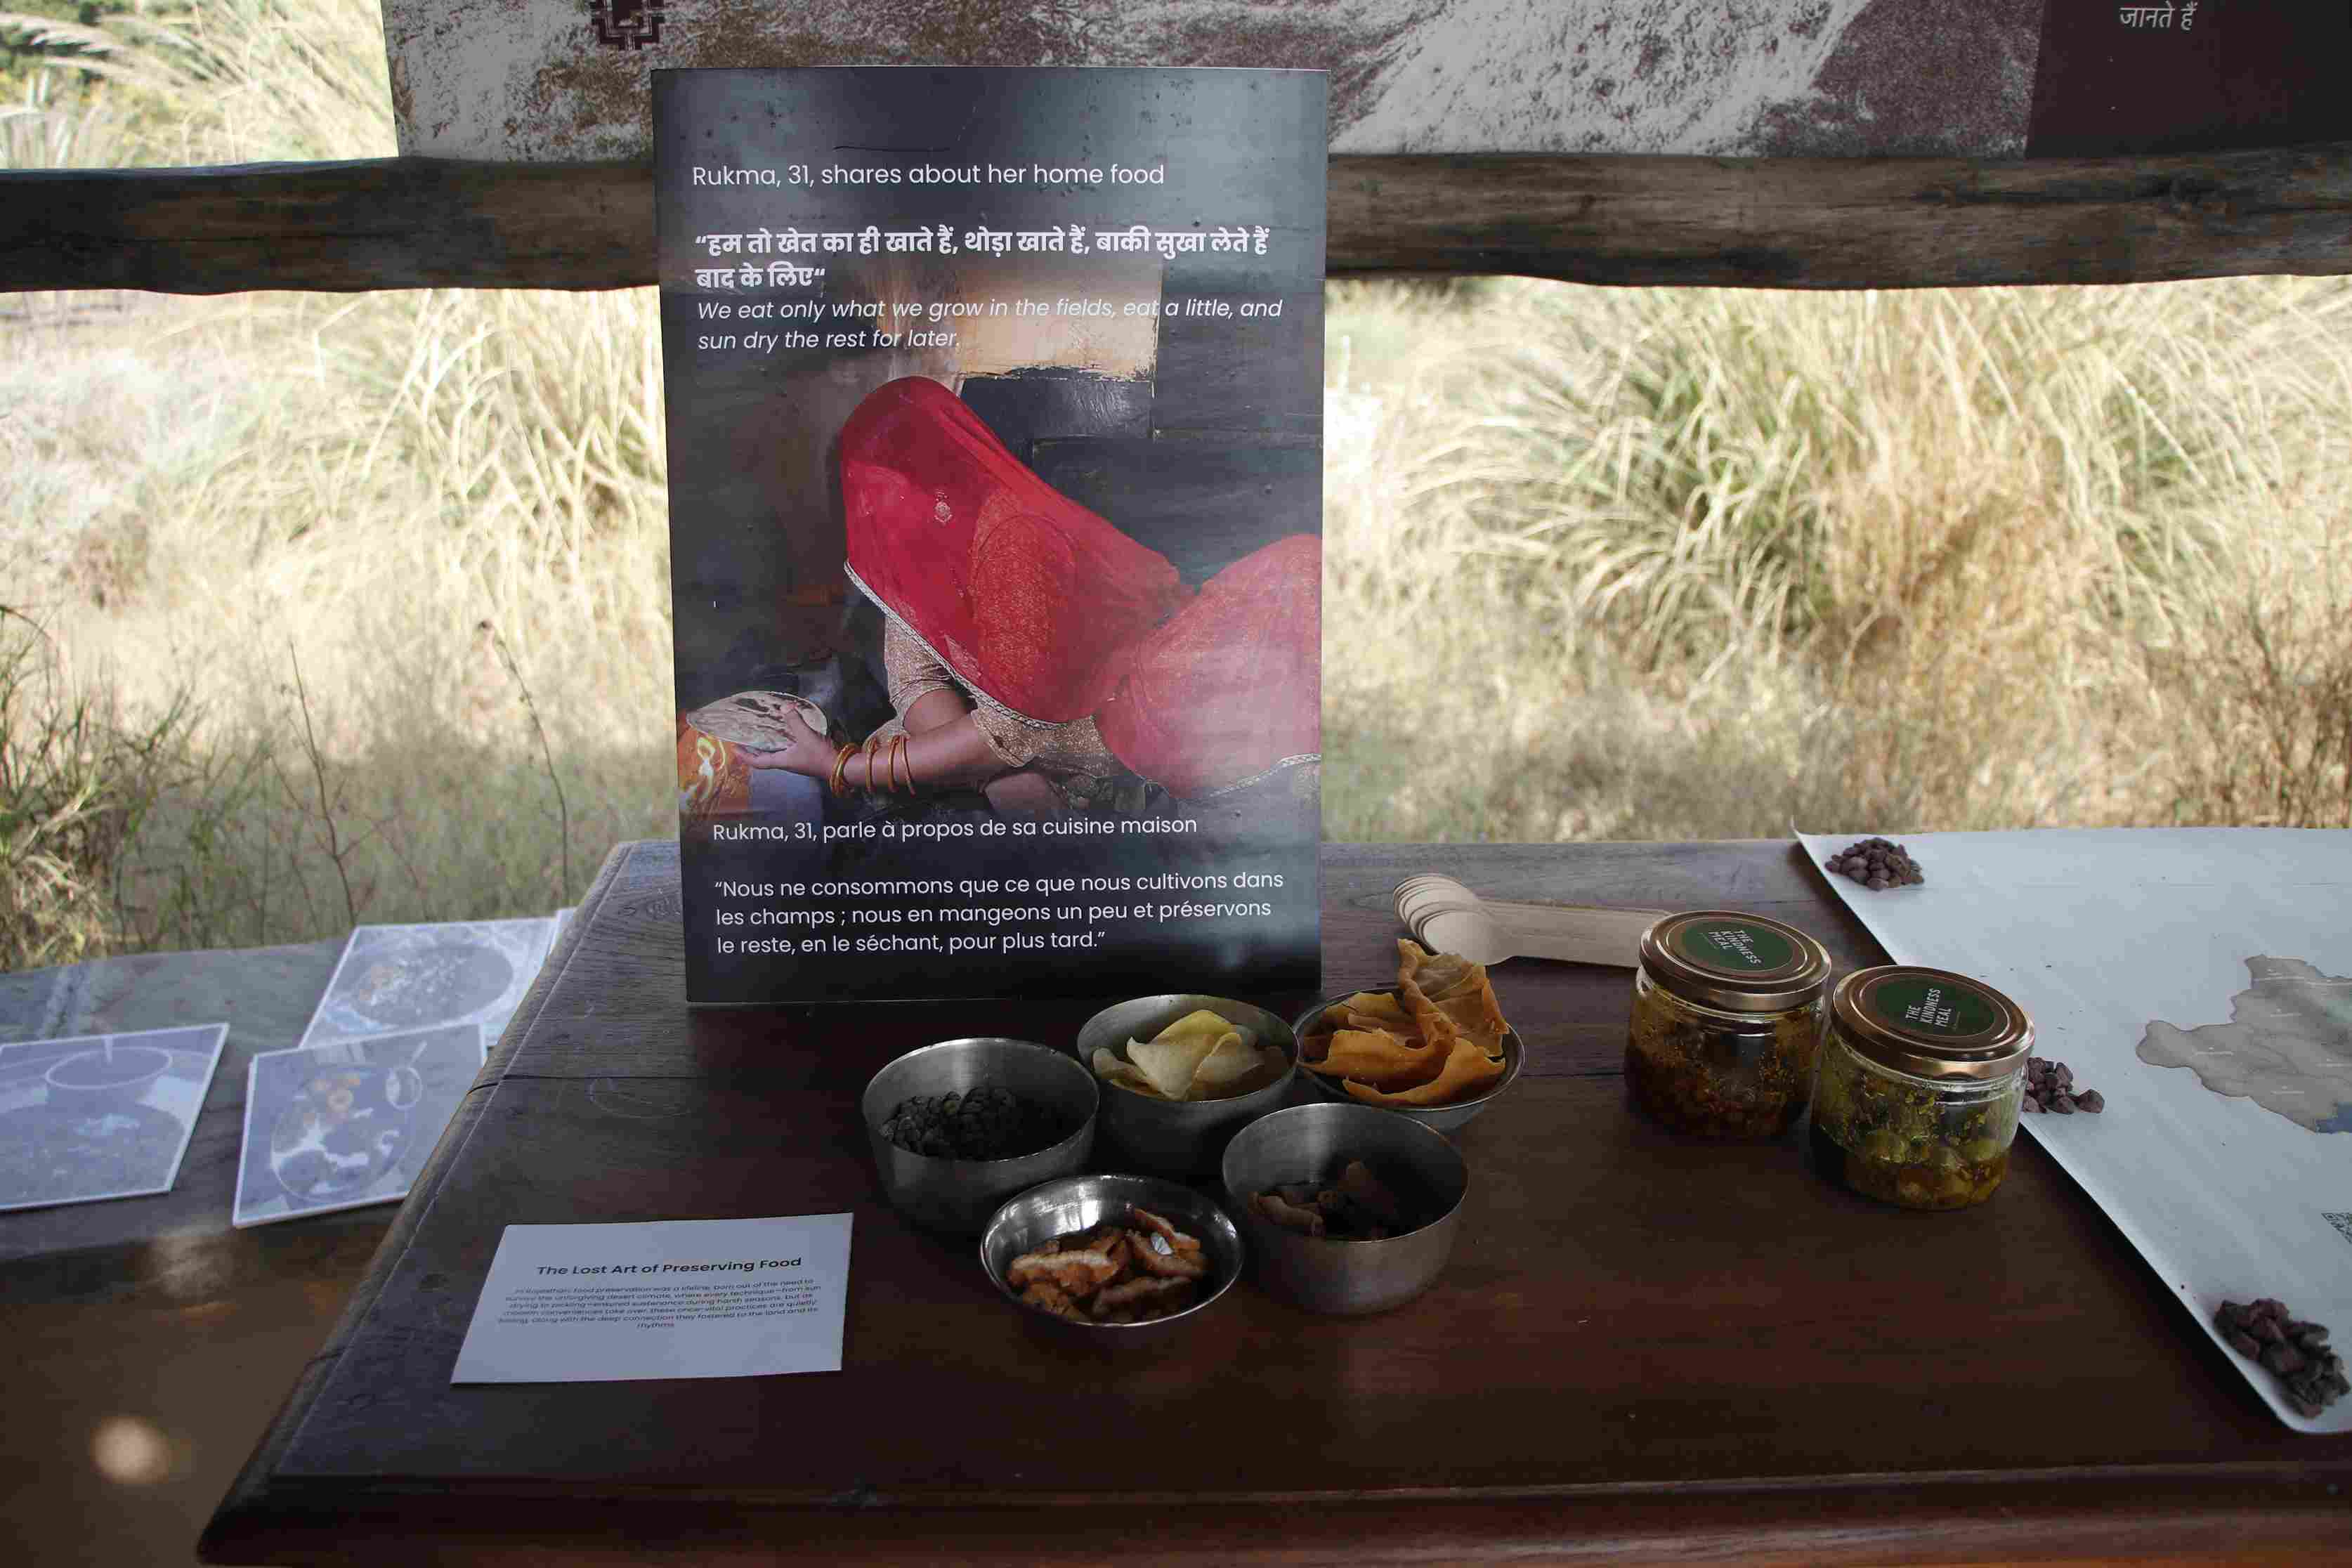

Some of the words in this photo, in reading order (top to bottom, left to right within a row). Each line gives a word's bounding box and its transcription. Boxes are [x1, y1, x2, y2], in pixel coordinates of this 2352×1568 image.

[2119, 1, 2176, 28] जानते
[2180, 1, 2199, 31] हैं
[693, 165, 781, 188] Rukma,
[788, 164, 814, 188] 31,
[821, 164, 902, 184] shares
[908, 163, 981, 183] about
[988, 163, 1027, 183] her
[1033, 164, 1104, 184] home
[1110, 163, 1164, 185] food
[695, 234, 743, 257] “हम
[745, 227, 773, 254] तो
[776, 227, 818, 254] खेत
[821, 233, 854, 253] का
[856, 226, 882, 255] ही
[884, 226, 934, 252] खाते
[936, 224, 958, 255] हैं,
[965, 226, 1013, 258] थोड़ा
[1016, 226, 1066, 252] खाते
[1068, 224, 1090, 254] हैं,
[1095, 225, 1152, 252] बाकी
[1154, 232, 1208, 259] सुखा
[1209, 226, 1250, 253] लेते
[1252, 225, 1271, 255] हैं
[694, 268, 736, 289] बाद
[738, 261, 764, 287] के
[698, 301, 731, 320] We
[738, 301, 775, 319] eat
[780, 300, 826, 323] only
[832, 299, 887, 318] what
[891, 301, 922, 319] we
[928, 303, 984, 322] grow
[988, 298, 1008, 316] in
[1015, 298, 1050, 316] the
[1056, 298, 1117, 319] fields,
[1123, 298, 1161, 318] eat
[1165, 302, 1180, 316] a
[1185, 298, 1233, 320] little,
[1240, 299, 1283, 317] and
[698, 335, 736, 350] sun
[743, 331, 779, 354] dry
[785, 329, 819, 348] the
[825, 331, 867, 348] rest
[873, 329, 902, 347] for
[907, 329, 960, 347] later.
[713, 823, 789, 842] Rukma,
[794, 822, 817, 842] 31,
[823, 821, 877, 844] parle
[882, 820, 895, 838] à
[901, 823, 974, 842] propos
[979, 818, 1007, 836] de
[1012, 822, 1036, 835] sa
[1042, 817, 1115, 835] cuisine
[1121, 816, 1197, 834] maison
[714, 881, 774, 897] “Nous
[780, 882, 806, 896] ne
[811, 880, 953, 896] consommons
[959, 880, 999, 899] que
[1005, 879, 1030, 893] ce
[1035, 878, 1076, 897] que
[1081, 877, 1131, 891] nous
[1136, 872, 1227, 890] cultivons
[1233, 871, 1283, 889] dans
[716, 908, 745, 925] les
[750, 908, 835, 929] champs
[852, 909, 902, 923] nous
[908, 909, 933, 922] en
[939, 907, 1051, 927] mangeons
[1057, 906, 1083, 920] un
[1088, 906, 1128, 925] peu
[1133, 902, 1154, 918] et
[1159, 900, 1271, 923] préservons
[717, 936, 735, 954] le
[740, 936, 796, 955] reste,
[801, 939, 827, 953] en
[832, 935, 850, 952] le
[856, 934, 943, 953] séchant,
[949, 936, 997, 955] pour
[1002, 932, 1045, 954] plus
[1050, 930, 1106, 948] tard.”
[1708, 931, 1733, 950] MEAL
[1720, 930, 1762, 965] KINDNESS
[1733, 929, 1754, 944] THE
[1905, 1005, 1921, 1020] THE
[1919, 988, 1941, 1024] KINDNESS
[1934, 1007, 1952, 1027] MEAL
[537, 1266, 568, 1275] The
[572, 1265, 608, 1275] Lost
[610, 1265, 639, 1274] Art
[640, 1264, 660, 1274] of
[662, 1261, 755, 1273] Preserving
[759, 1257, 802, 1269] Food
